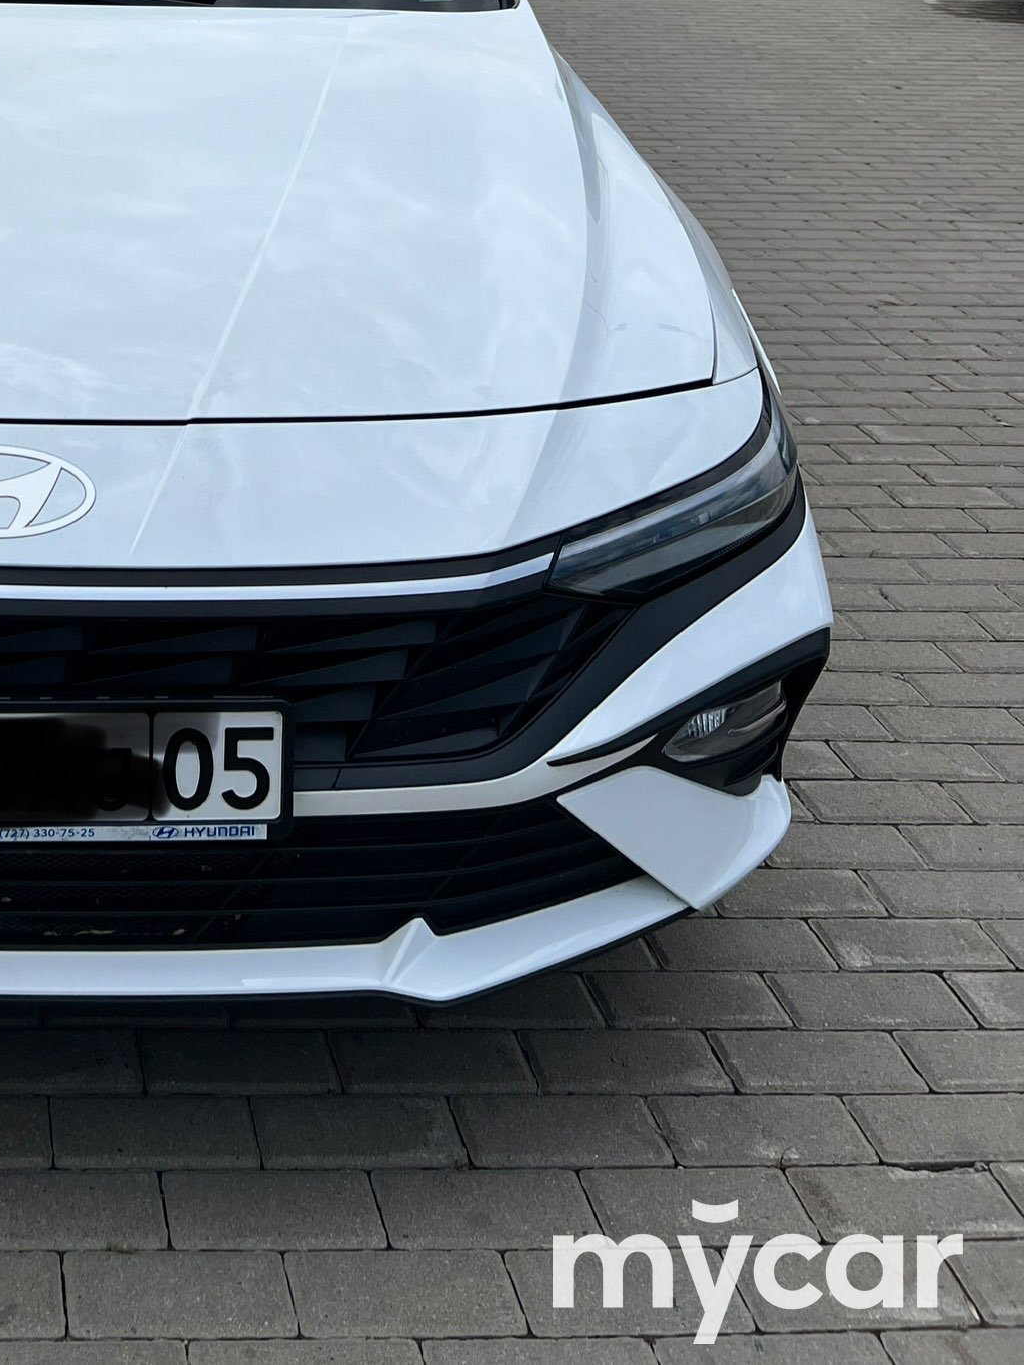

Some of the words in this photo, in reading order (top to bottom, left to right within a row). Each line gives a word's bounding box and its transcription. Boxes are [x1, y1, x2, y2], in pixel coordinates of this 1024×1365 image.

[163, 726, 274, 811] 05
[33, 828, 95, 838] 330-75-25
[184, 826, 255, 837] HYUNDAI
